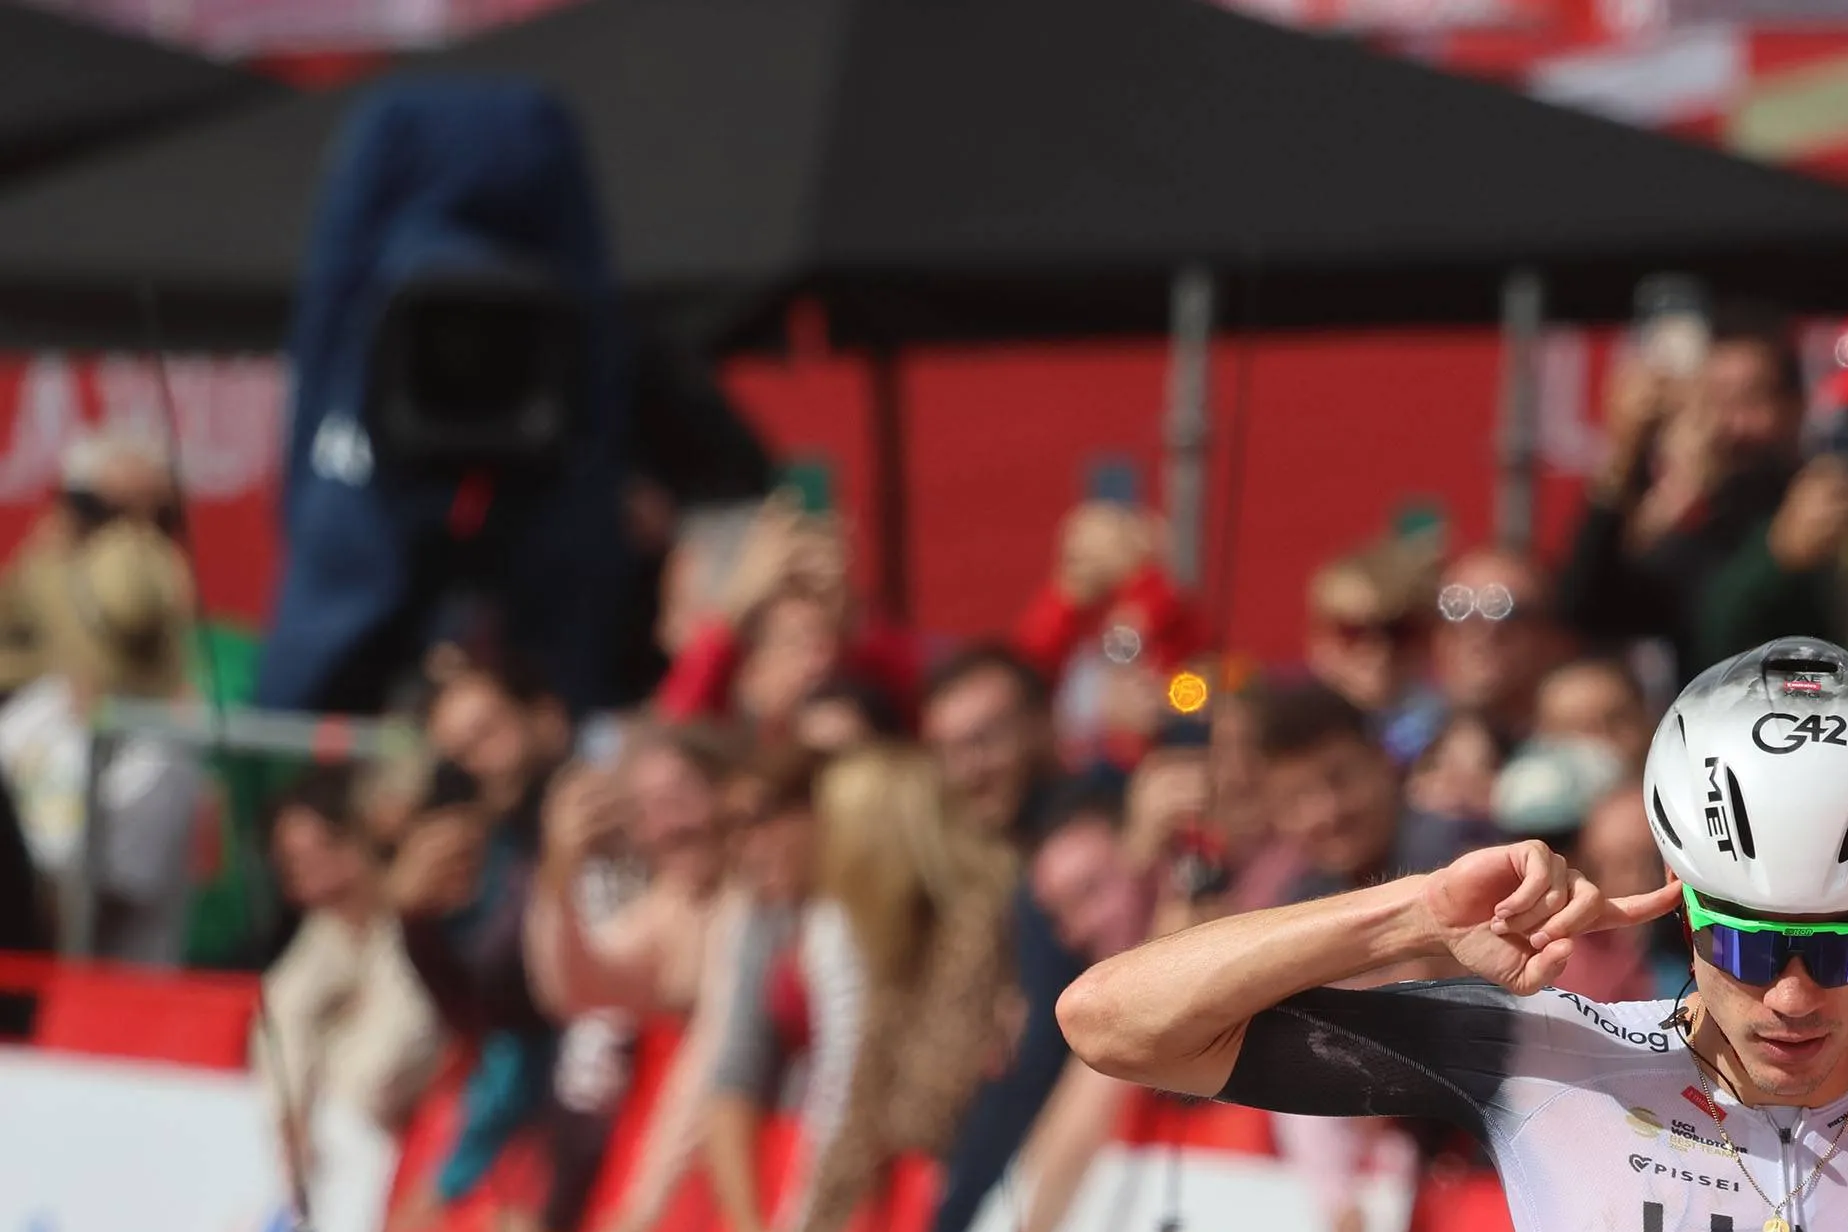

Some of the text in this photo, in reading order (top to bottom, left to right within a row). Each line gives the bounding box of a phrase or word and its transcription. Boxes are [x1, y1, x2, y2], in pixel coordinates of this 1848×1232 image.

[1751, 712, 1848, 755] G42
[1704, 756, 1738, 862] MET
[1558, 992, 1670, 1053] Analog
[1671, 1119, 1696, 1133] UCI
[1653, 1162, 1740, 1192] PISSEI
